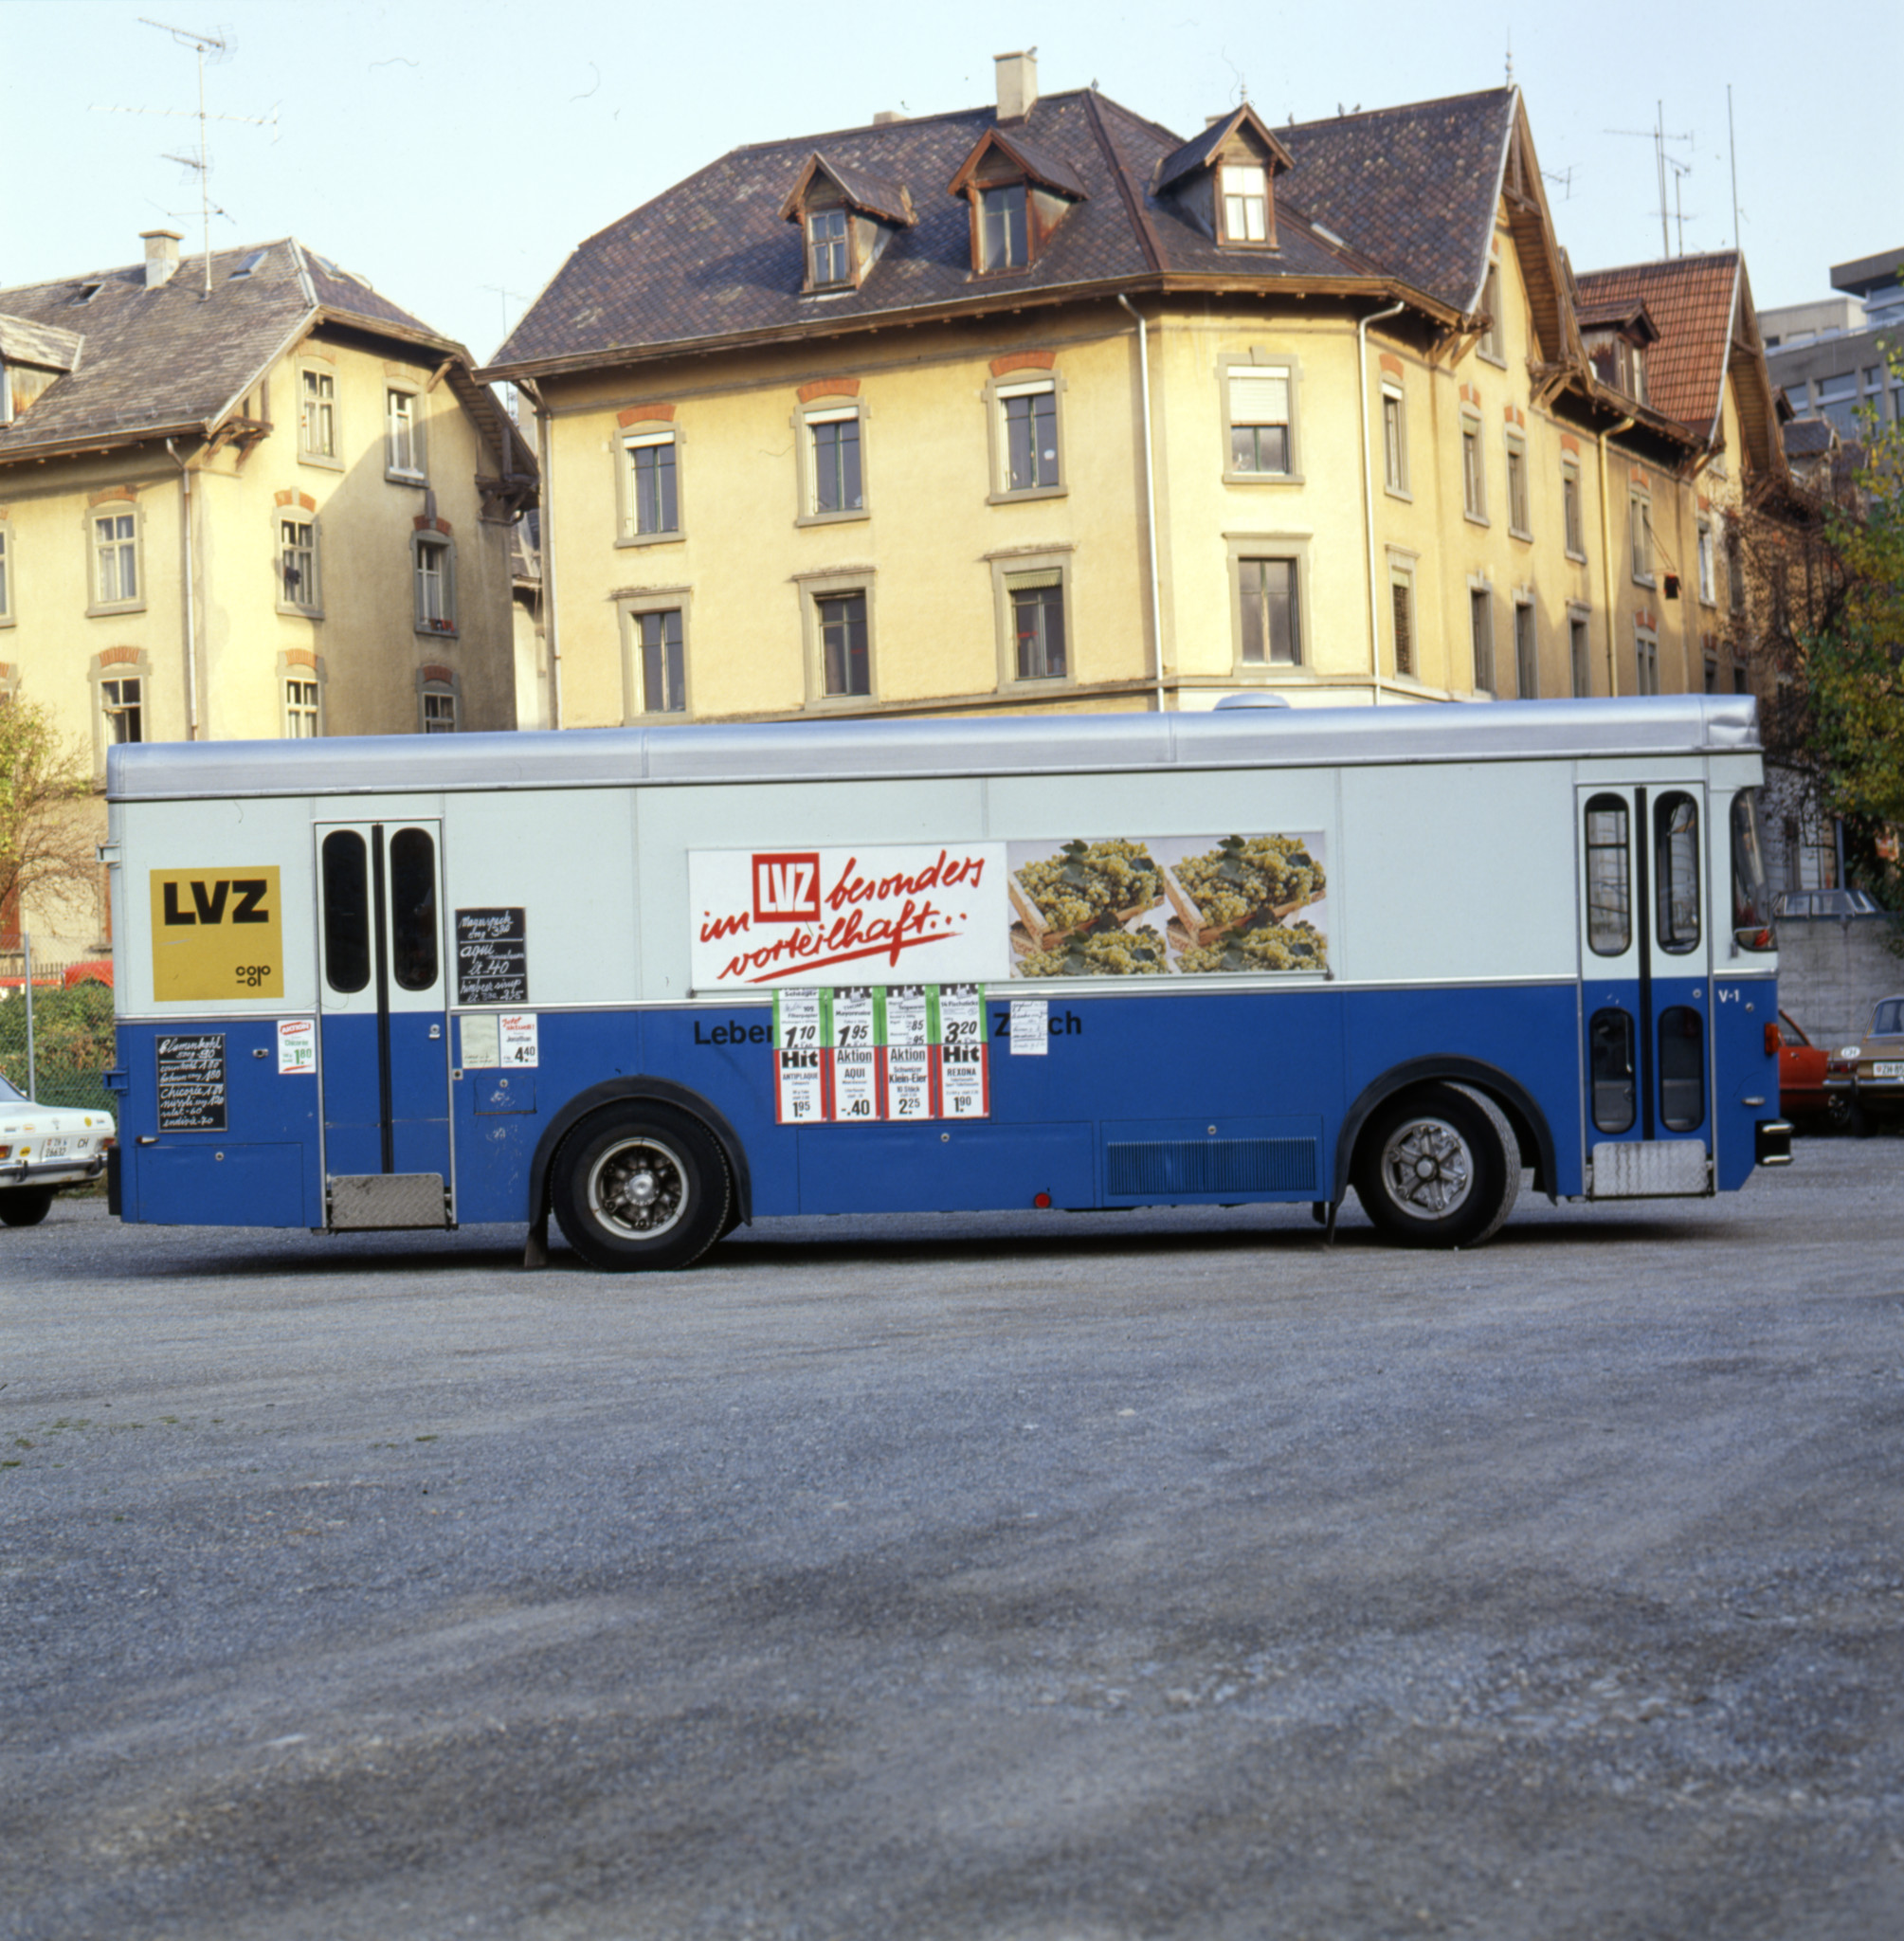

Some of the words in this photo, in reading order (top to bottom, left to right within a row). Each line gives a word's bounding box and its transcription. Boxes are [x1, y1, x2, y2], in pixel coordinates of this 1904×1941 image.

[163, 879, 269, 926] LVZ
[700, 911, 750, 943] im
[758, 862, 816, 913] LVZ
[825, 849, 985, 911] besonders
[1718, 989, 1740, 1003] V-1
[781, 1050, 818, 1068] Hit
[837, 1049, 872, 1062] Aktion
[890, 1048, 926, 1061] Aktion
[943, 1045, 980, 1063] Hit
[782, 1072, 818, 1080] ANTIPLAQUE
[844, 1068, 865, 1079] AQUI
[889, 1073, 927, 1083] Klein-Eier
[947, 1068, 977, 1077] REXONA
[78, 1138, 90, 1149] CH
